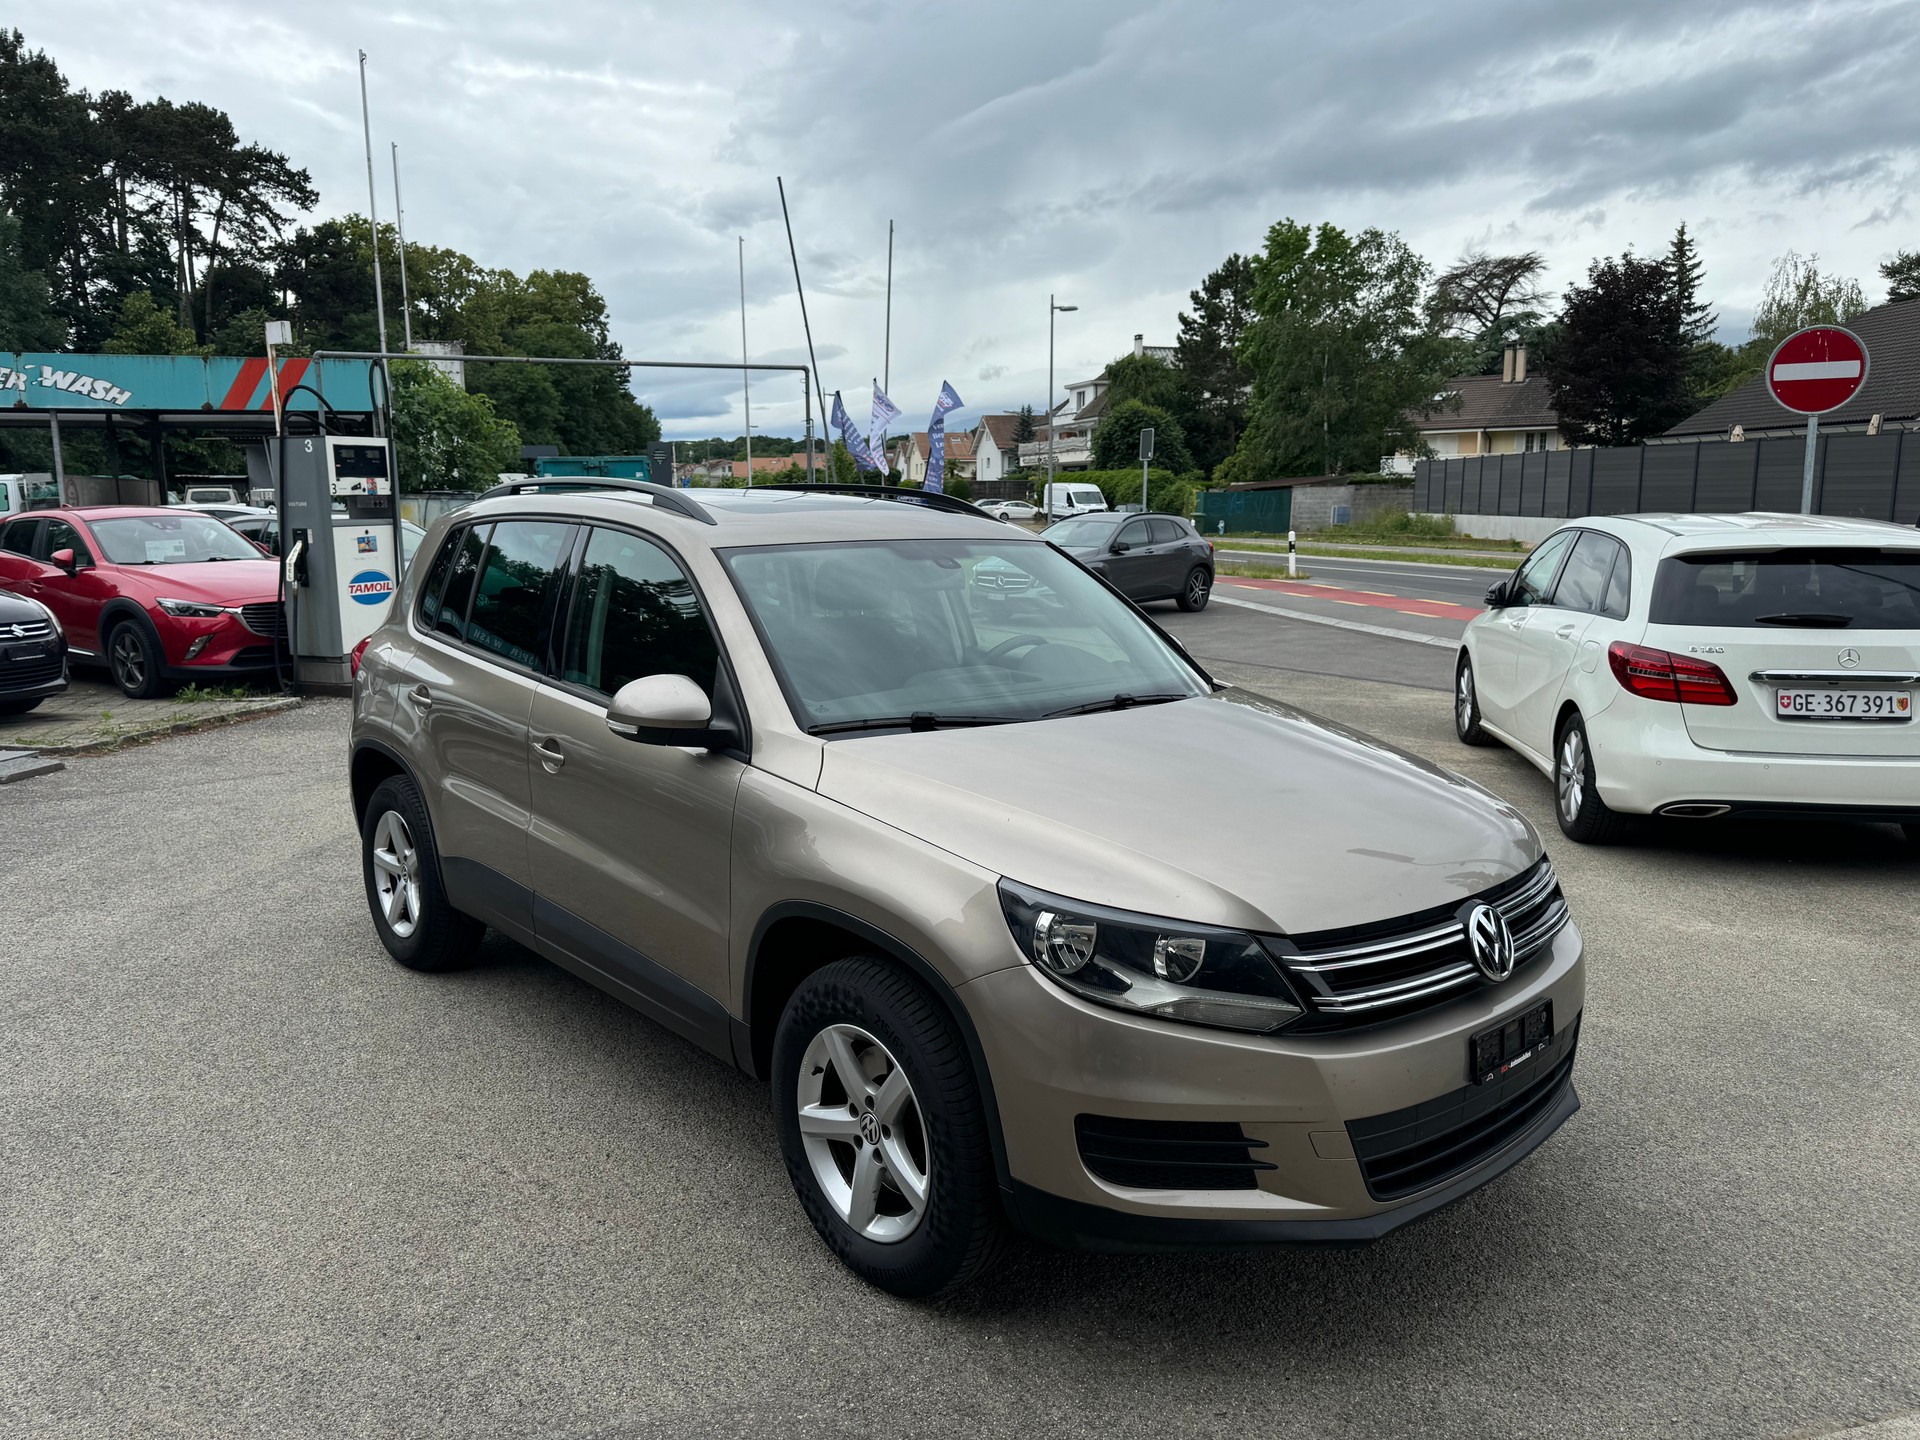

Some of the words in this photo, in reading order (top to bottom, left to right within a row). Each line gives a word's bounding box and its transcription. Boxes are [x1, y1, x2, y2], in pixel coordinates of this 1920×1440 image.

[41, 366, 132, 405] WASH
[304, 439, 313, 453] 3
[331, 483, 337, 494] 3
[348, 582, 393, 594] TAMOIL
